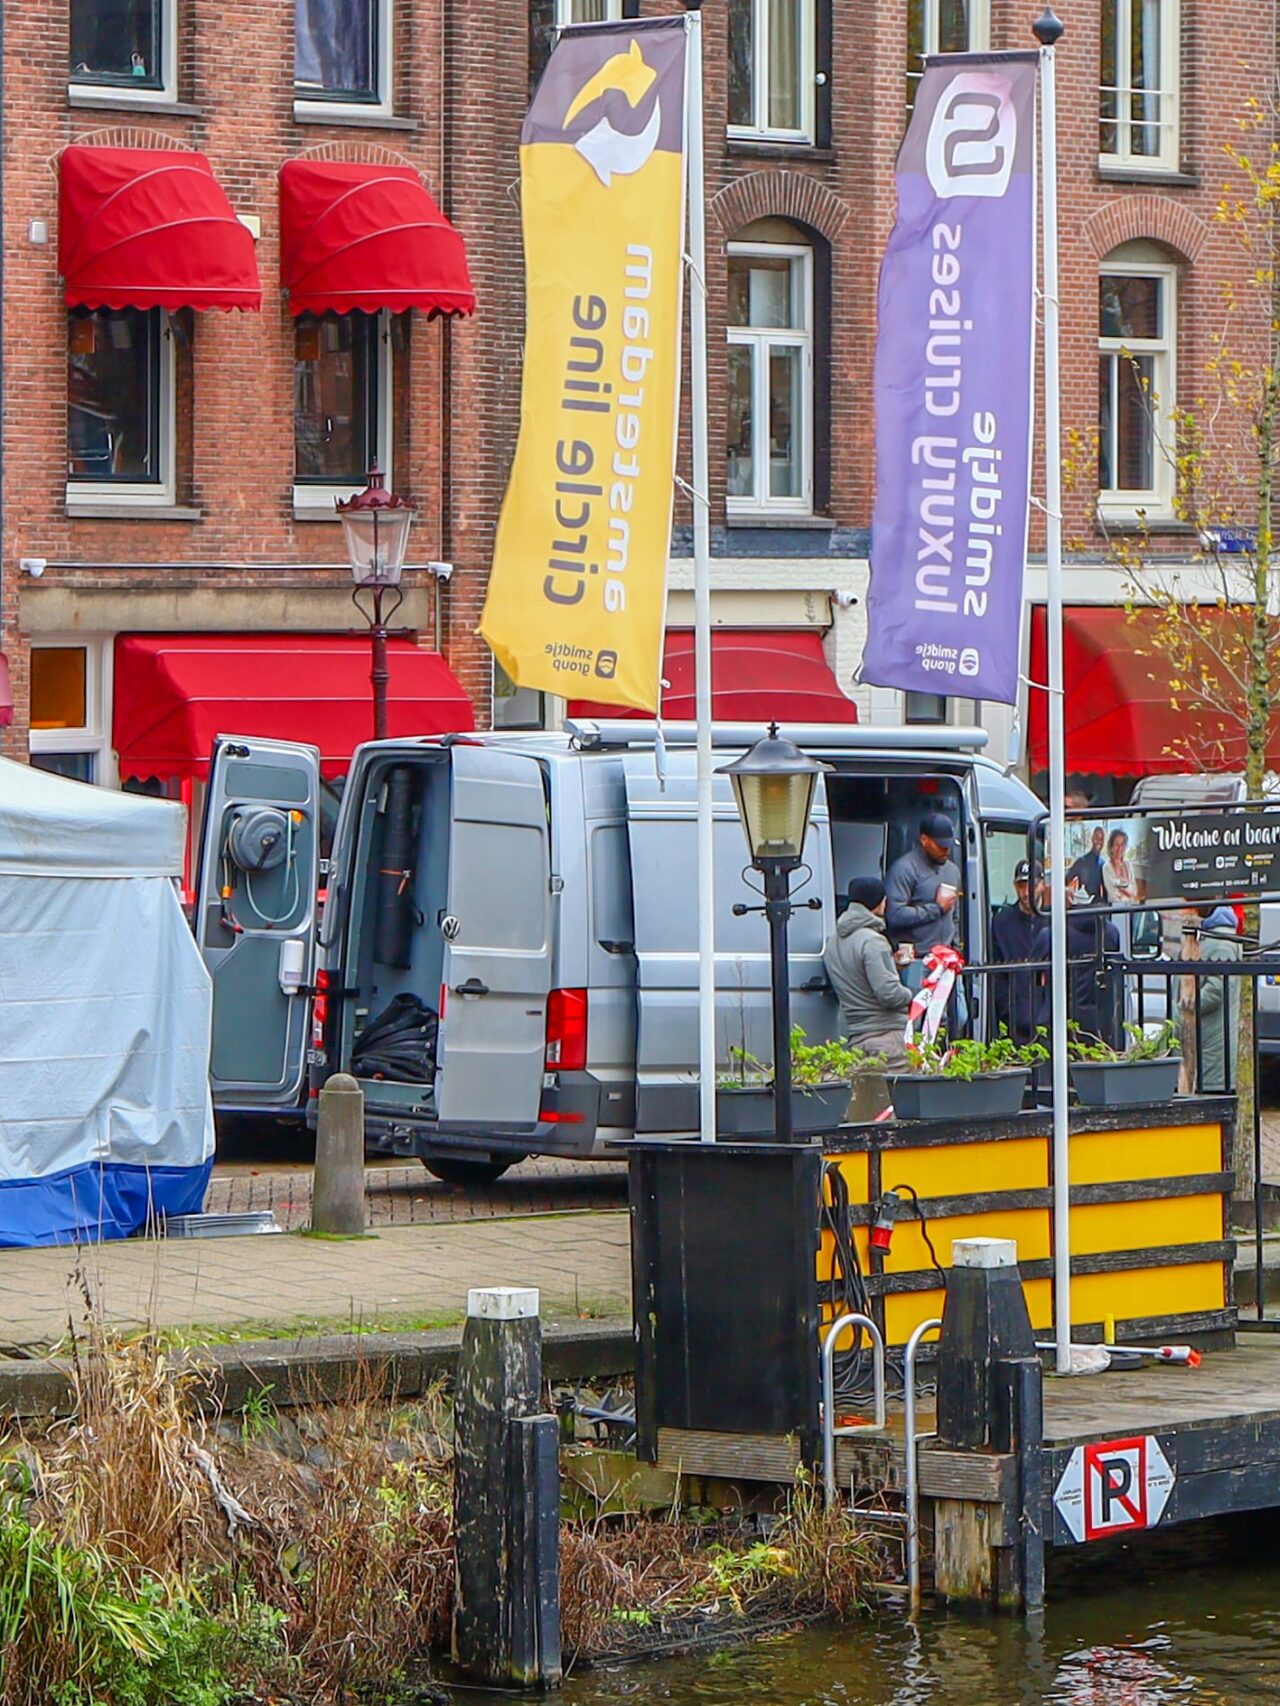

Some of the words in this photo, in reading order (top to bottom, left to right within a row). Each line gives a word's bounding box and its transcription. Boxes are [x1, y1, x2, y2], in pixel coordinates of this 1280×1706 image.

[1152, 820, 1221, 851] Welcome
[1223, 828, 1242, 846] on
[1102, 1457, 1132, 1523] P
